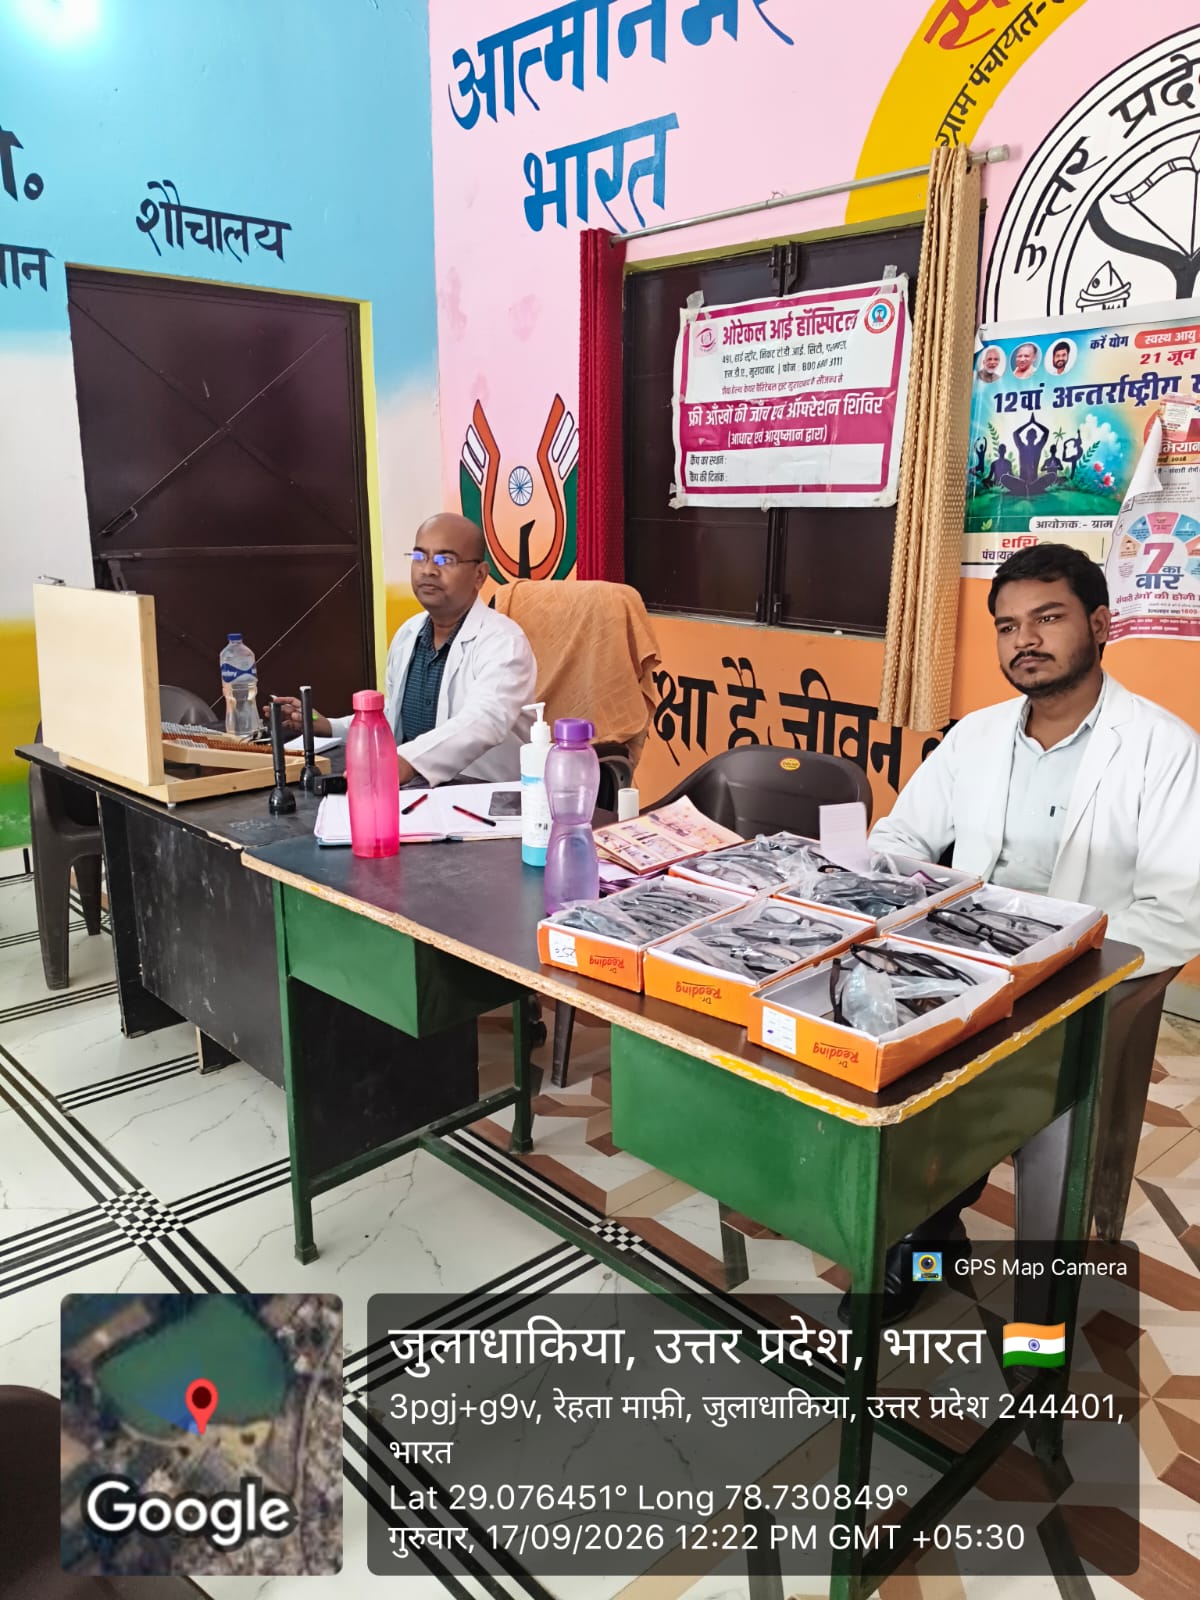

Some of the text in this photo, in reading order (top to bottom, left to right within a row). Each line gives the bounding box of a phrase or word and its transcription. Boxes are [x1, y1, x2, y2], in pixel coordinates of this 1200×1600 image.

[935, 83, 977, 147] ग्राम
[524, 112, 680, 233] भारत
[1014, 53, 1200, 281] उत्तर प्रदे
[136, 179, 292, 263] शौचालय
[722, 305, 861, 346] ओरेकल आई हॉस्पिटल
[1090, 333, 1130, 350] करें योग
[1144, 332, 1172, 345] स्वस्थ
[760, 348, 776, 360] निकट
[1139, 348, 1197, 366] 21 जून
[993, 382, 1045, 413] 12वां
[688, 406, 703, 427] फ्री
[705, 402, 733, 426] आँखों
[734, 403, 748, 423] की
[749, 399, 770, 422] जाँच
[786, 393, 840, 420] ऑपरेशन
[843, 391, 885, 415] शिविर
[764, 428, 803, 446] आयुष्मान
[805, 424, 828, 443] द्वारा)
[1091, 519, 1113, 530] ग्राम
[1144, 543, 1174, 574] 7
[1162, 566, 1182, 574] का
[1136, 573, 1184, 589] वार
[652, 670, 718, 766] क्षा
[722, 656, 767, 750] है
[767, 668, 902, 793] जीवन
[588, 955, 625, 969] Reading
[675, 980, 722, 998] Reading
[701, 995, 713, 1004] Dr
[812, 1042, 859, 1064] Reading
[838, 1060, 849, 1069] Dr
